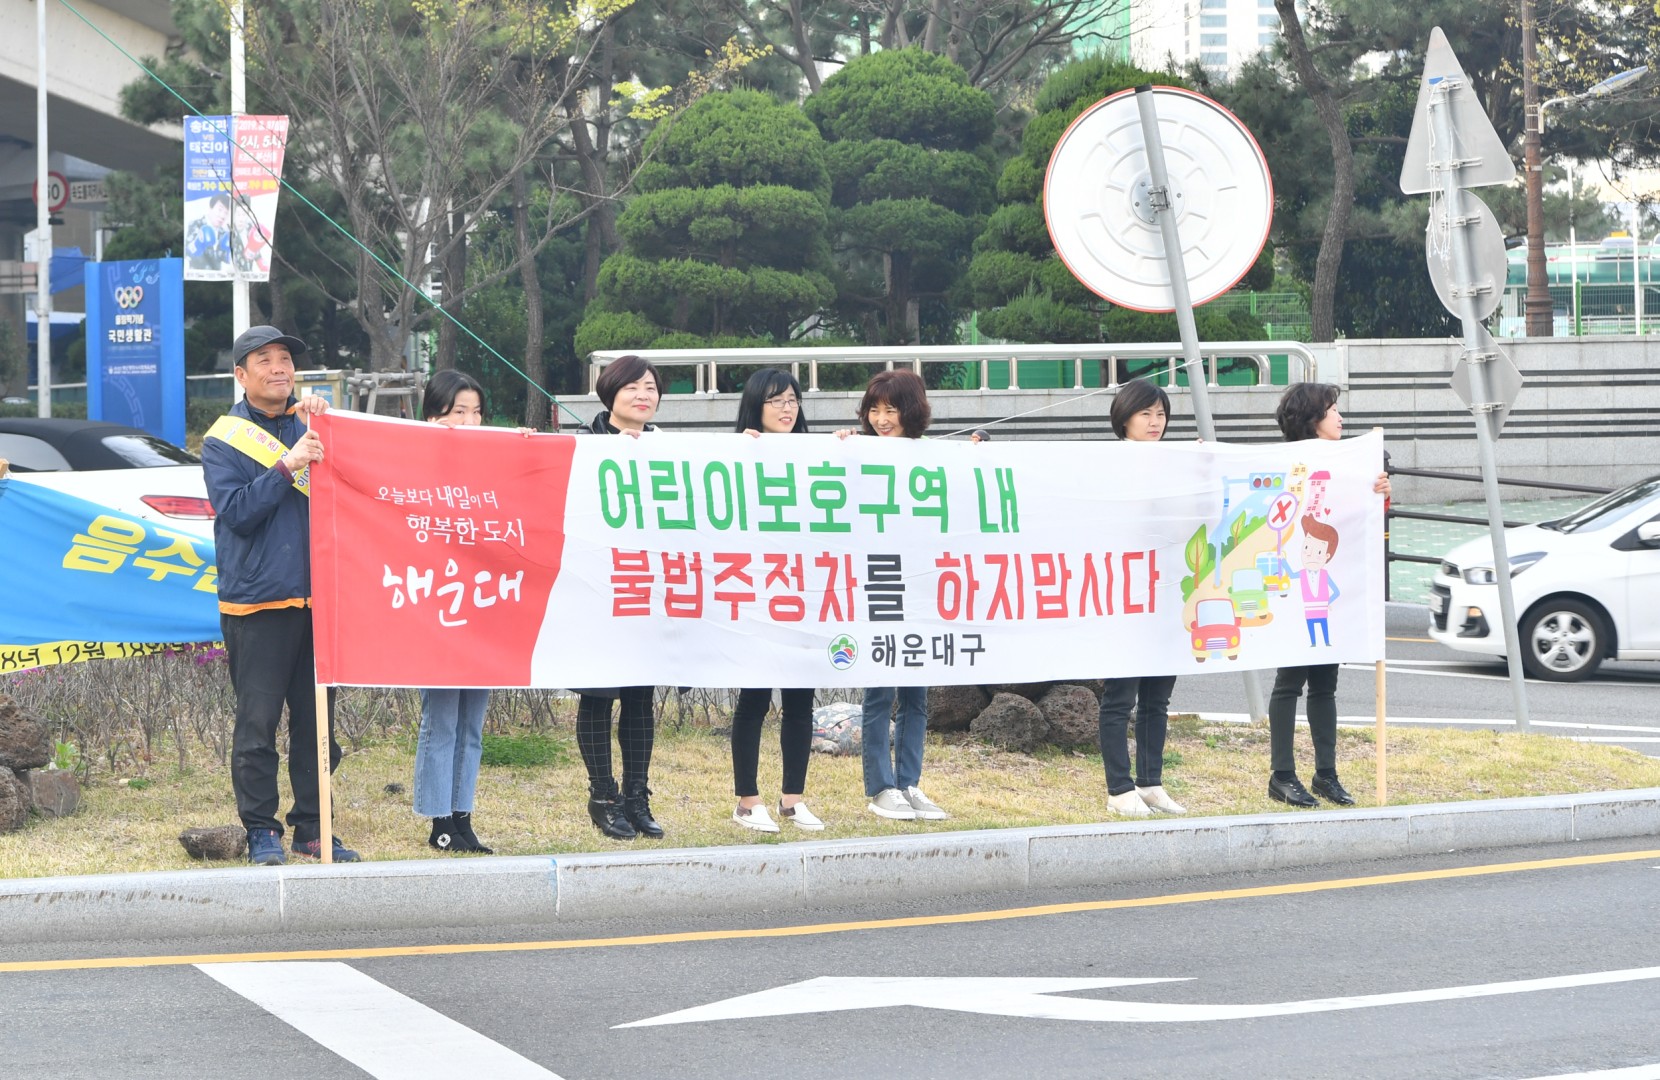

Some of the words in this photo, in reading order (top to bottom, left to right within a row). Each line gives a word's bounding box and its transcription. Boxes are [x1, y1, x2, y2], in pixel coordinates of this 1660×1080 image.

[189, 141, 228, 153] 태진아
[48, 183, 60, 200] 0
[108, 329, 152, 343] 국민생활관
[374, 486, 433, 507] 오늘보다
[436, 485, 481, 510] 내일이
[482, 490, 499, 509] 더
[598, 459, 949, 534] 어린이보호구역
[973, 467, 1020, 534] 내
[405, 513, 480, 546] 행복한
[483, 518, 525, 547] 도시
[382, 558, 524, 627] 해운대
[610, 547, 906, 622] 불법주정차를
[934, 549, 1161, 622] 하지맙시다
[871, 633, 987, 668] 해운대구
